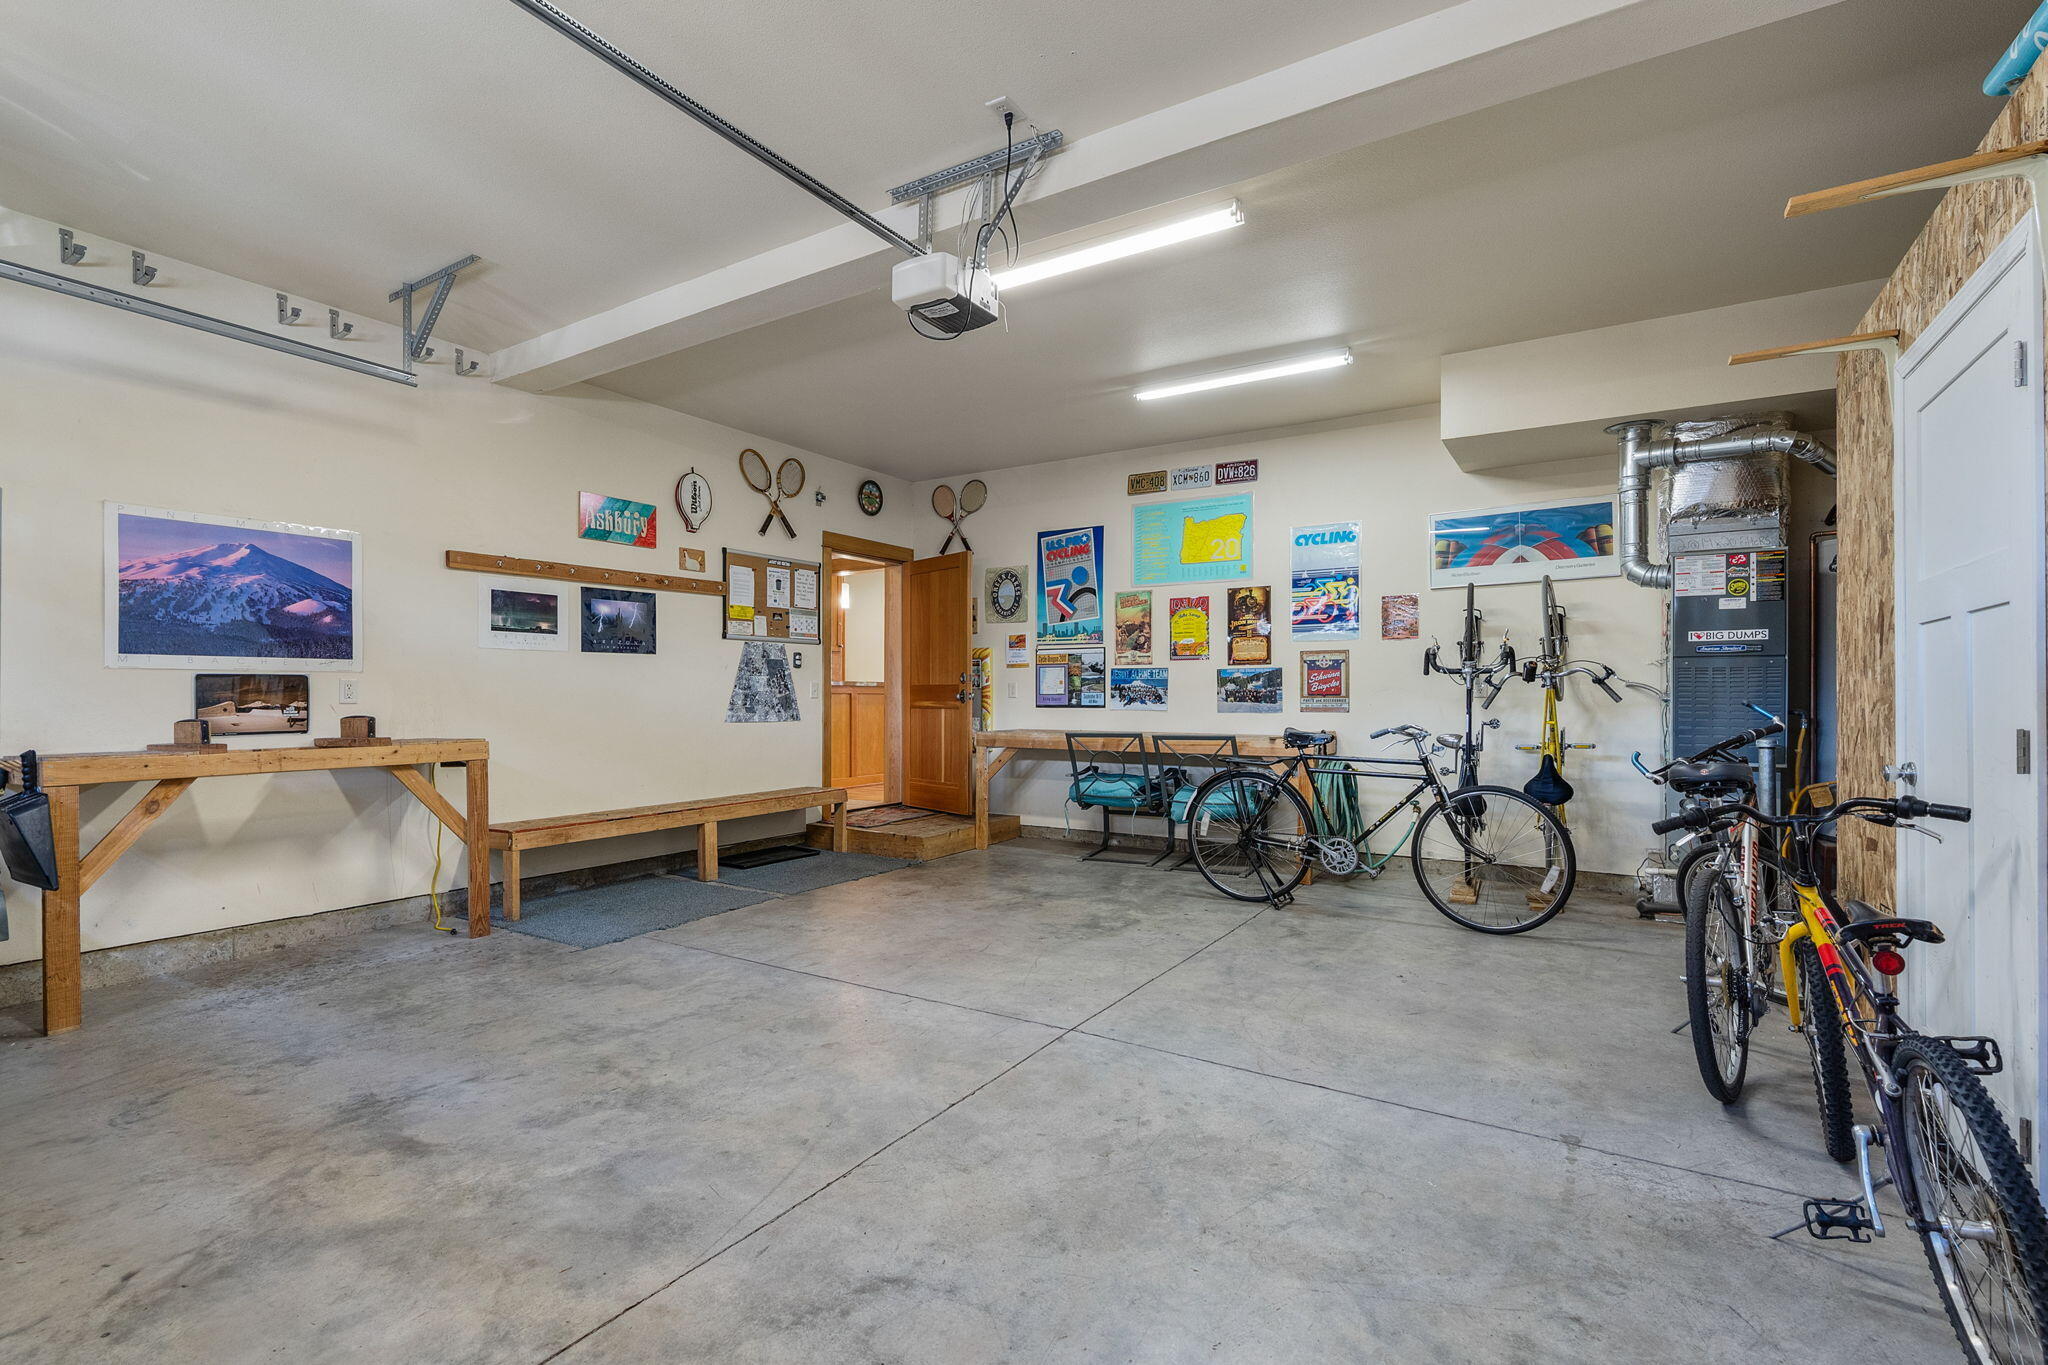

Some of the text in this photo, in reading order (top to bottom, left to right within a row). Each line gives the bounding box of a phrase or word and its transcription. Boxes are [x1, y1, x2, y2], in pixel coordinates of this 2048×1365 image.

[1193, 470, 1210, 484] 860
[1238, 464, 1256, 478] 826
[690, 480, 698, 514] Wilson
[1294, 530, 1357, 547] CYCLING
[1045, 543, 1090, 562] CYCLING
[1210, 538, 1239, 560] 20
[1007, 572, 1021, 596] LAKES
[1705, 631, 1724, 640] BIG
[1727, 630, 1767, 640] DUMPS
[1152, 669, 1168, 680] TEAM
[1308, 671, 1341, 683] Schwinn
[1310, 679, 1341, 692] Bicycles
[1873, 922, 1907, 930] TREK
